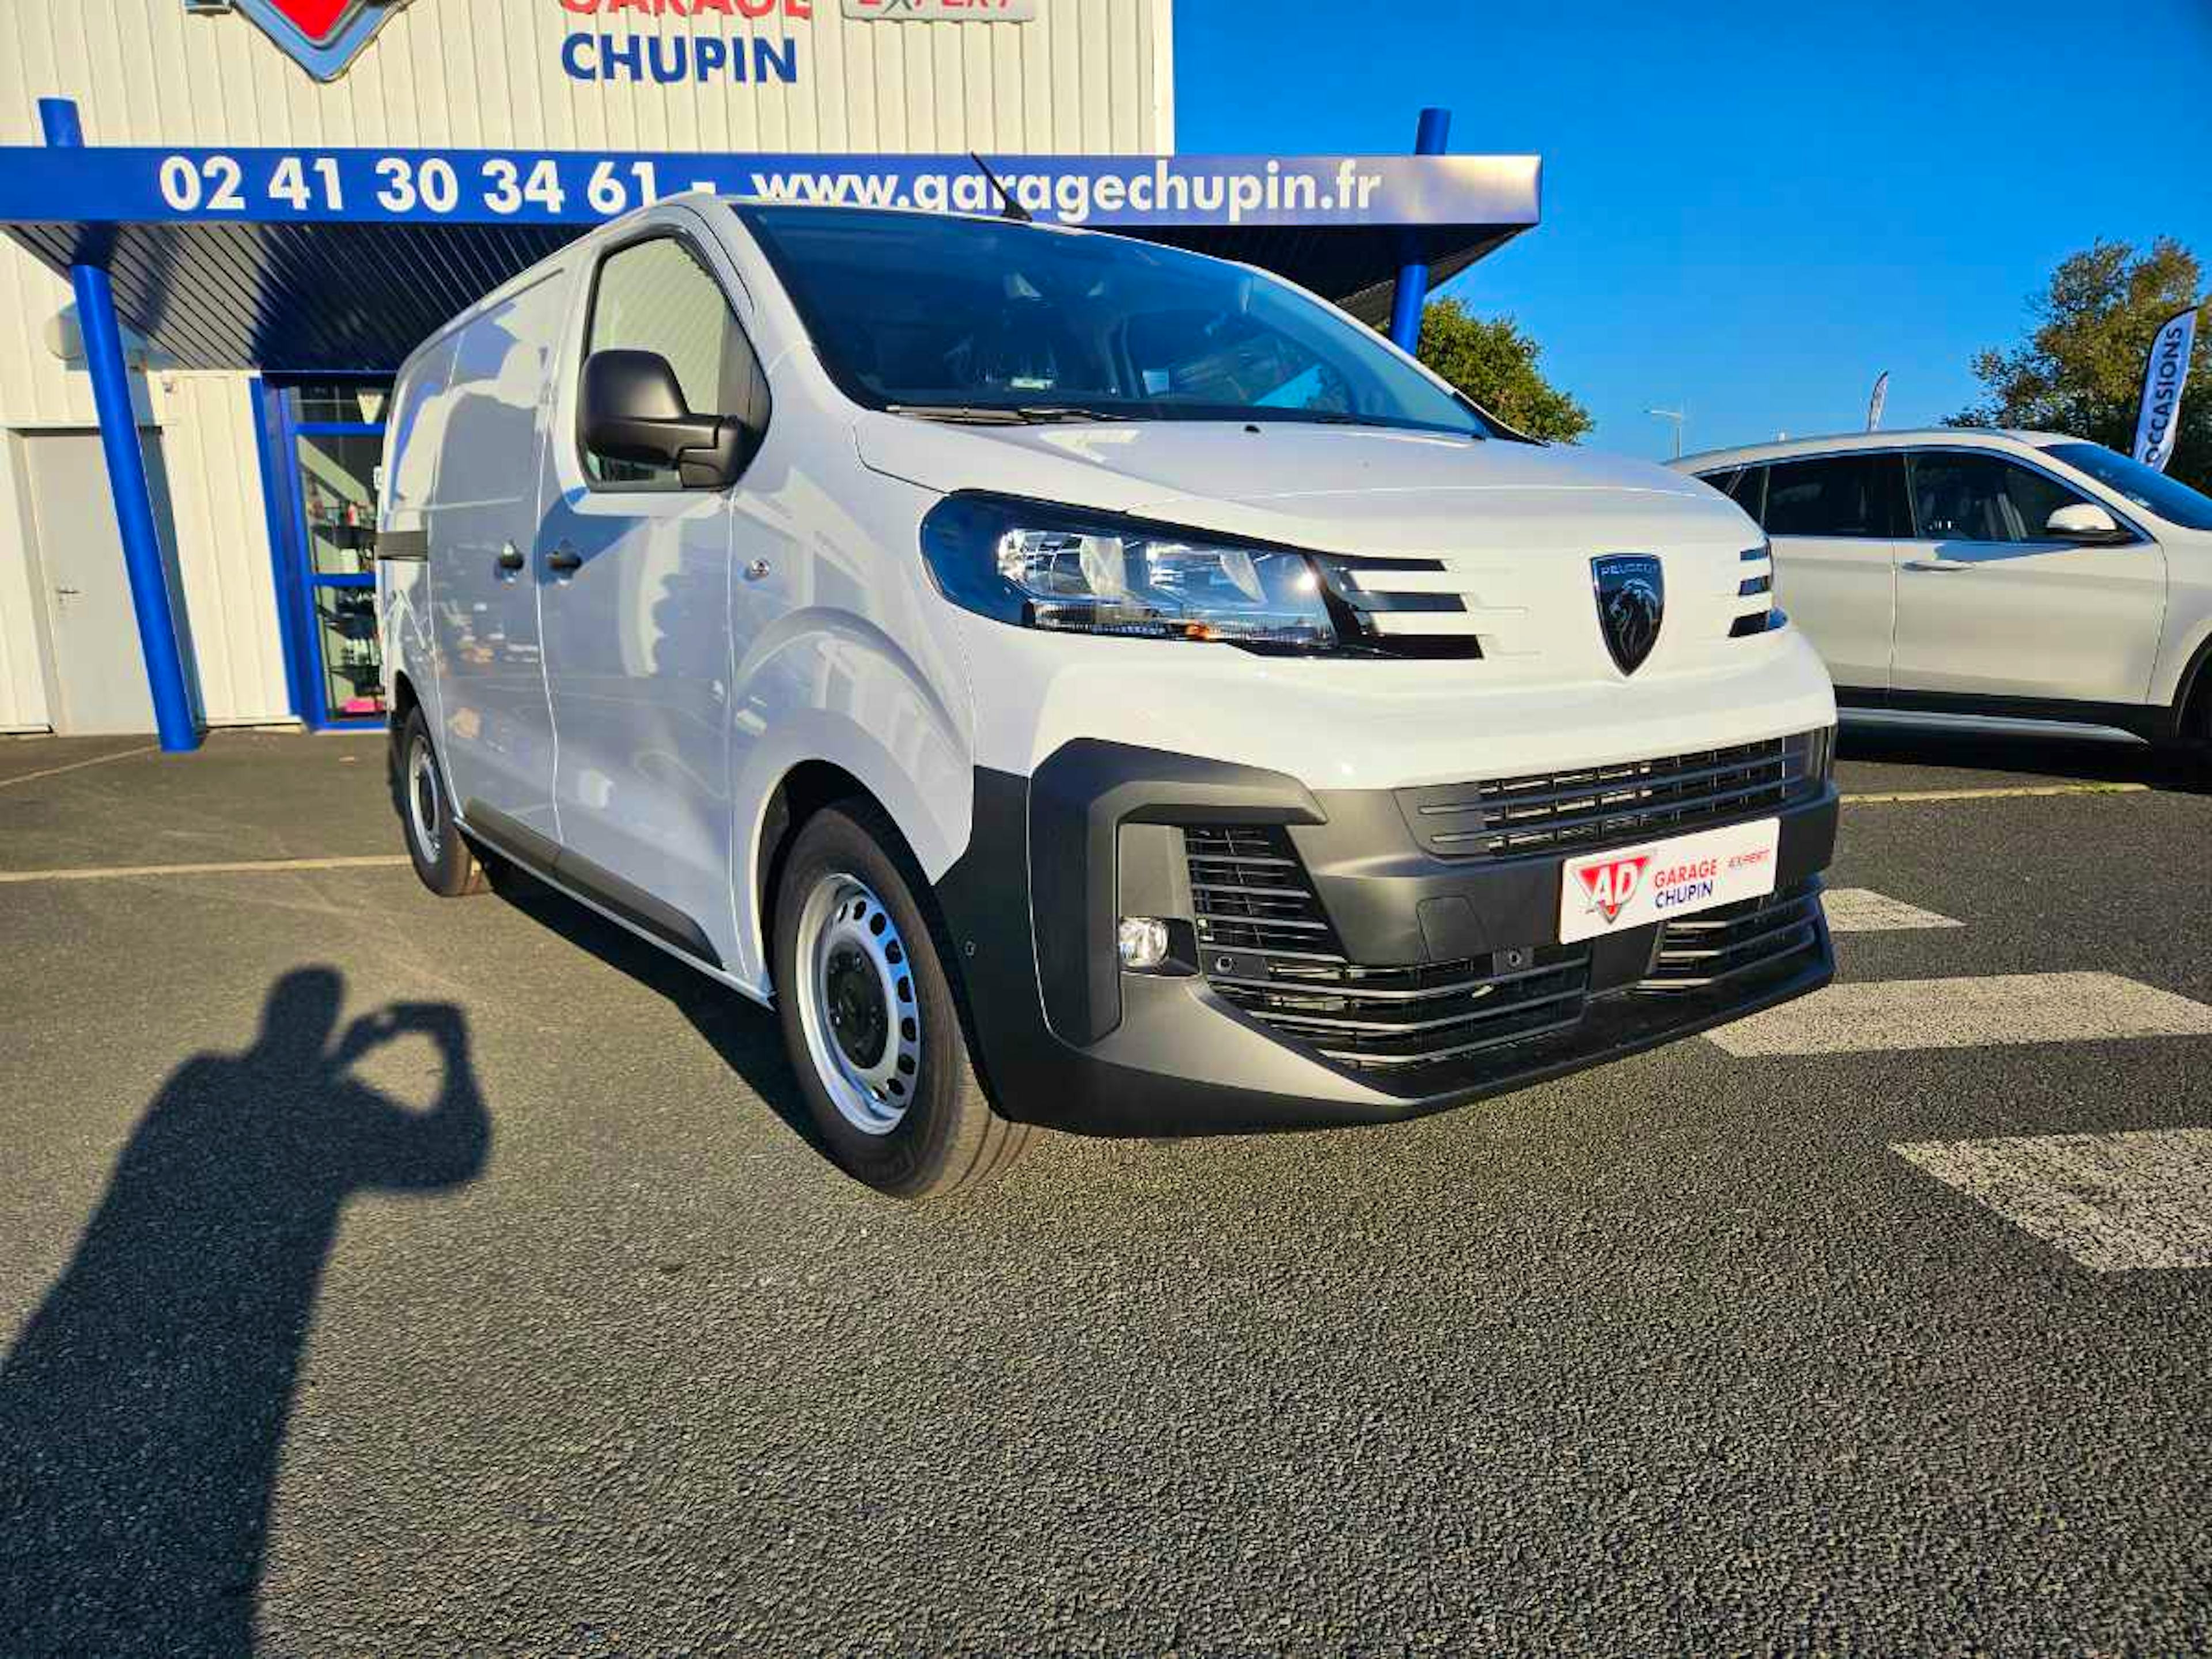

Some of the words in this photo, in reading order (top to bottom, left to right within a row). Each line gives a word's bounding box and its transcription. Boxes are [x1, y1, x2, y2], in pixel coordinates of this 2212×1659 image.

[561, 33, 797, 83] CHUPIN
[159, 158, 245, 211] 02
[268, 158, 343, 210] 41
[376, 157, 459, 213] 30
[484, 160, 565, 212] 34
[587, 161, 657, 213] 61
[751, 160, 1381, 221] www.garagechupin.fr
[2146, 327, 2183, 464] OCCASIONS
[1592, 861, 1638, 905] AD
[1655, 860, 1718, 888] GARAGE
[1656, 880, 1714, 909] CHUPIN
